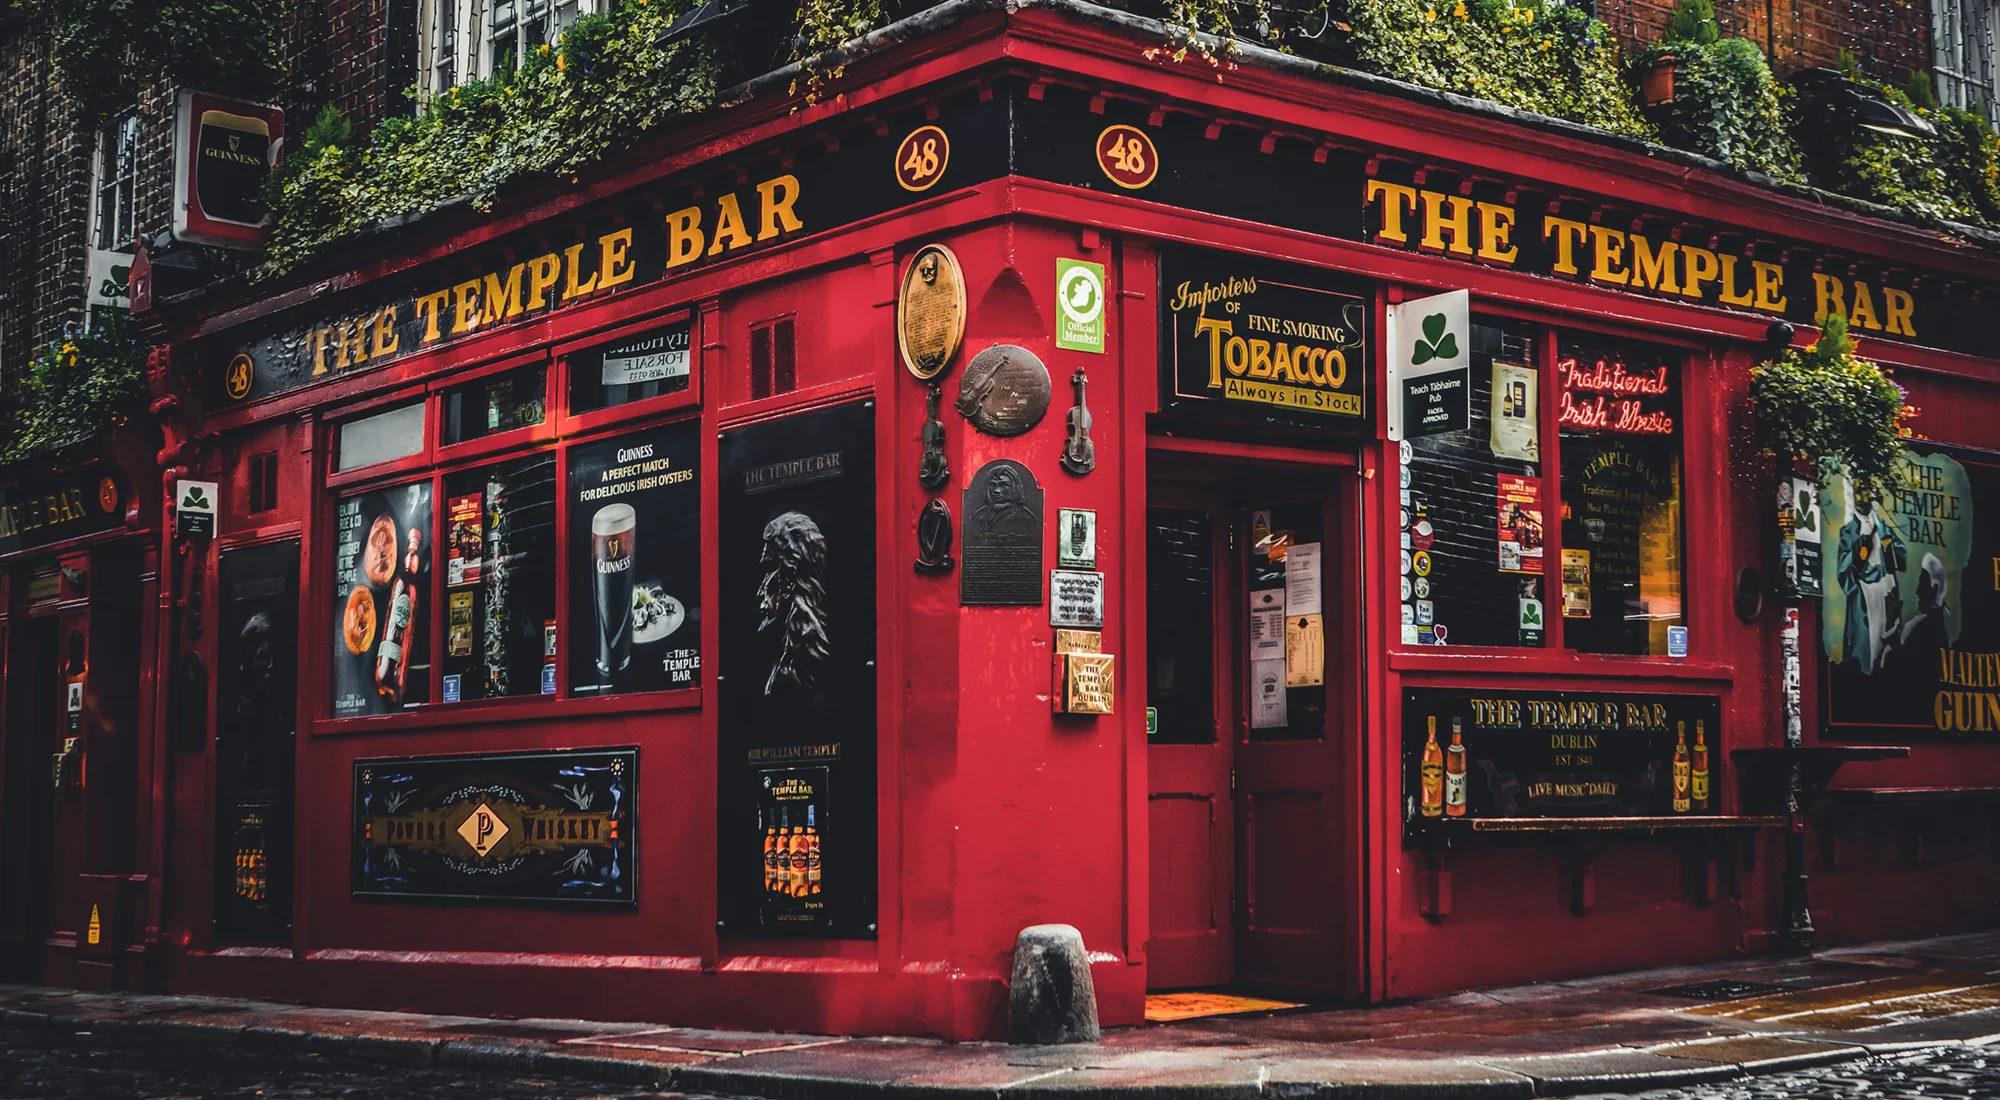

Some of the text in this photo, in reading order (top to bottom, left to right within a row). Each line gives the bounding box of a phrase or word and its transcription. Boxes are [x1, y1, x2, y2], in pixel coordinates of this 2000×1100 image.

[205, 147, 261, 166] GUINNESS
[904, 138, 938, 181] 48
[1107, 133, 1145, 173] 48
[1366, 179, 1917, 337] THE TEMPLE BAR
[306, 173, 804, 376] THE TEMPLE BAR
[1170, 275, 1257, 316] Importers
[1225, 301, 1241, 314] OF
[1064, 330, 1098, 343] Member
[1067, 321, 1095, 333] Official
[1248, 314, 1346, 344] FINE SMOKING
[1194, 316, 1347, 389] TOBACCO
[230, 363, 247, 393] 48
[1558, 358, 1669, 394] Traditional
[1227, 380, 1359, 412] Always in Stock
[1410, 384, 1429, 395] Teach
[1429, 392, 1442, 403] Pub
[1558, 391, 1607, 426] Irish
[617, 444, 654, 464] GUINNESS
[816, 453, 841, 470] BAR
[1582, 451, 1632, 480] TEMPLE
[601, 457, 669, 483] A PERFECT MATCH
[1906, 461, 1944, 492] THE
[580, 469, 693, 502] FOR DELICIOUS IRISH OYSTERS
[1891, 489, 1961, 522] TEMPLE
[1908, 516, 1947, 548] BAR
[596, 555, 631, 574] GUINNESS
[1419, 604, 1430, 613] tax
[662, 656, 700, 672] TEMPLE
[673, 649, 690, 659] THE
[672, 669, 692, 682] BAR
[1077, 674, 1107, 683] TEMPLE
[1085, 665, 1099, 673] THE
[1939, 647, 2000, 688] MALTE
[1084, 685, 1100, 693] BAR
[1470, 699, 1669, 731] THE TEMPLE BAR
[1551, 734, 1598, 749] DUBLIN
[1555, 754, 1572, 766] EST
[771, 785, 814, 796] TEMPLE BAR
[1527, 782, 1619, 798] LIVE MUSIC DAILY
[475, 812, 494, 849] P
